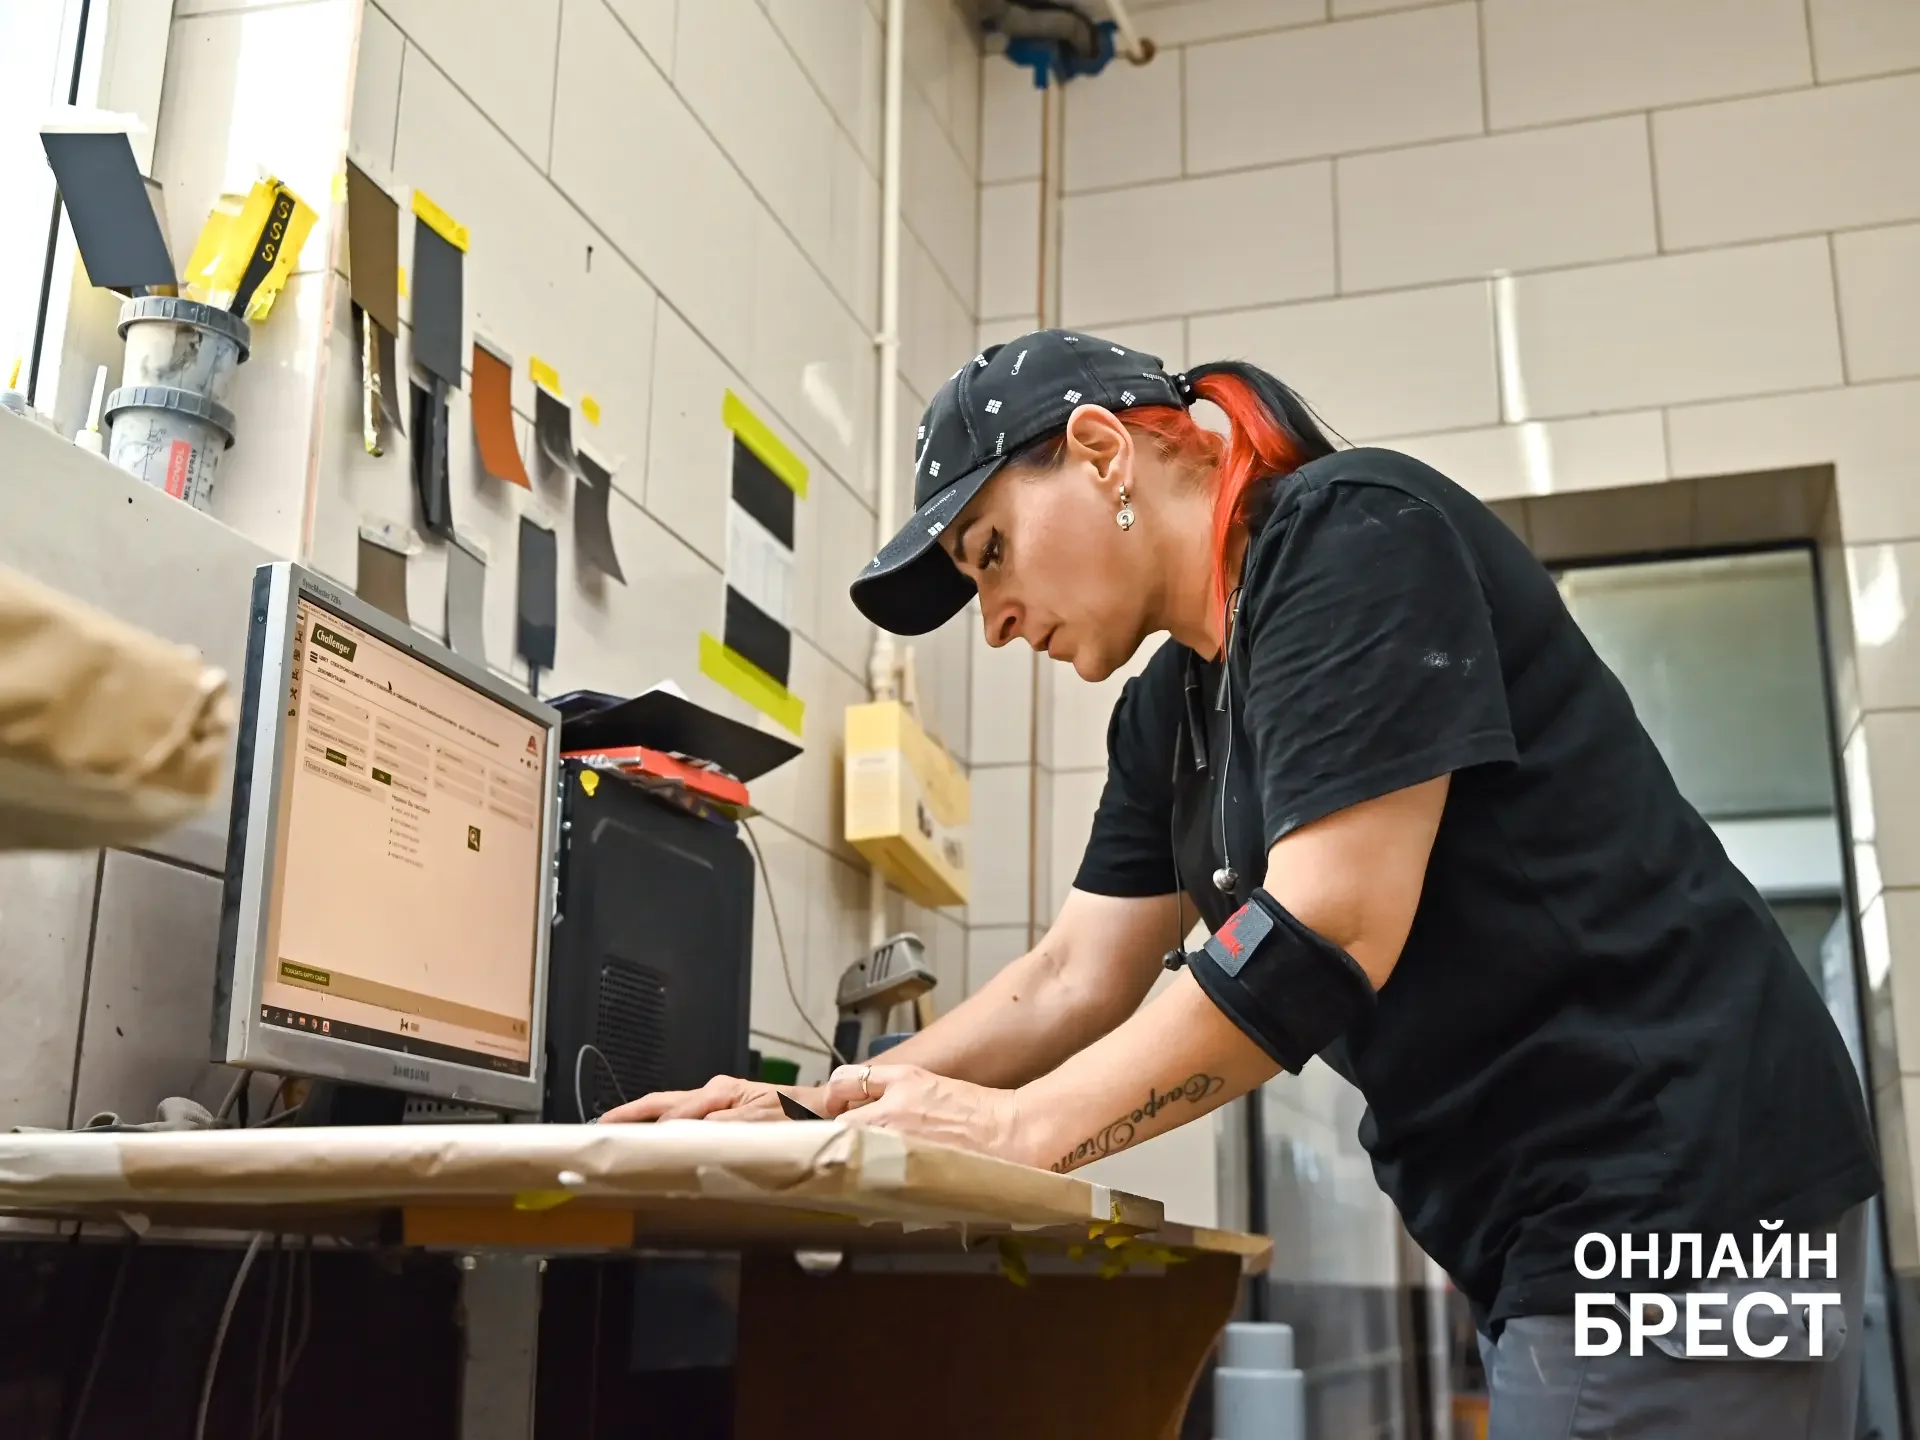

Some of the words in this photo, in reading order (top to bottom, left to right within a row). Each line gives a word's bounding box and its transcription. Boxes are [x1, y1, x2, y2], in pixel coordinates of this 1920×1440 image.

[1011, 349, 1028, 376] Columbia
[188, 448, 198, 475] SPRAY
[924, 489, 957, 517] Columbia
[316, 629, 351, 655] Challenger
[392, 1065, 430, 1082] SAMSUNG
[1131, 1072, 1225, 1123] Carpe
